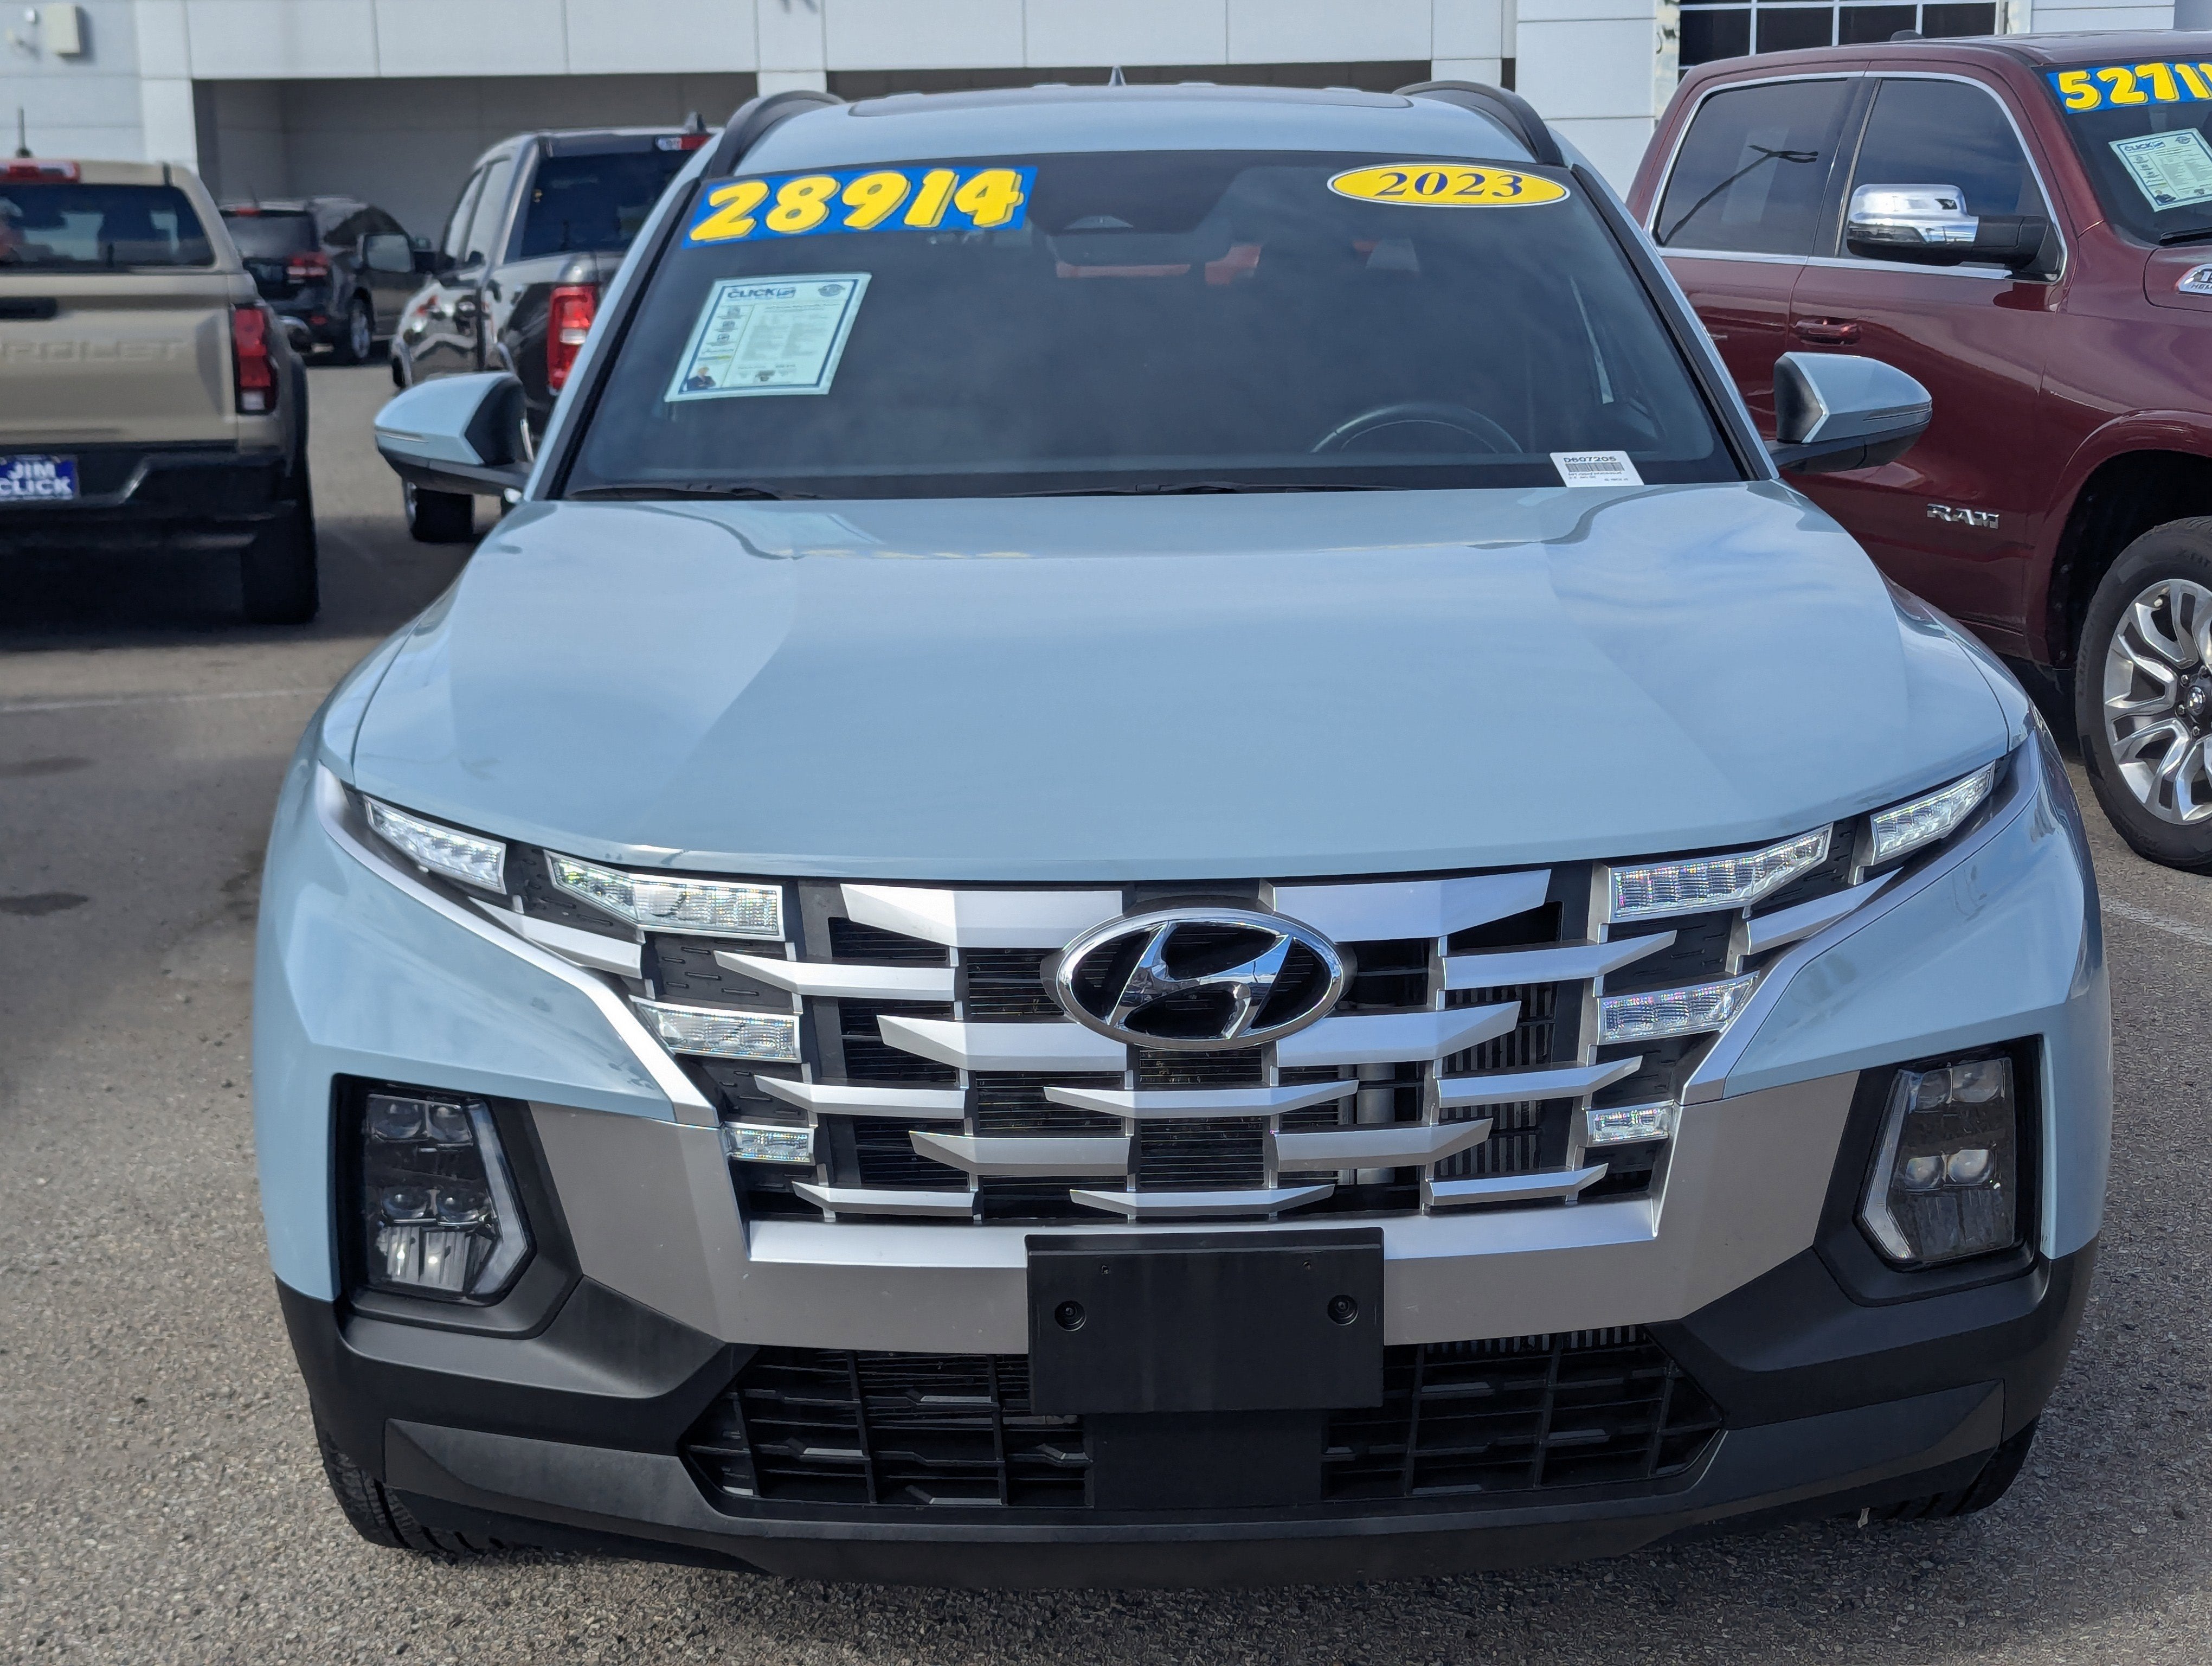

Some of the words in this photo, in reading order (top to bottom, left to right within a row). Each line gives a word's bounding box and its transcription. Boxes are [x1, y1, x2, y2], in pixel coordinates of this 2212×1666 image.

[1374, 171, 1523, 197] 2023
[690, 169, 1024, 241] 28914
[7, 461, 56, 479] JIM
[1927, 503, 1999, 529] RAM
